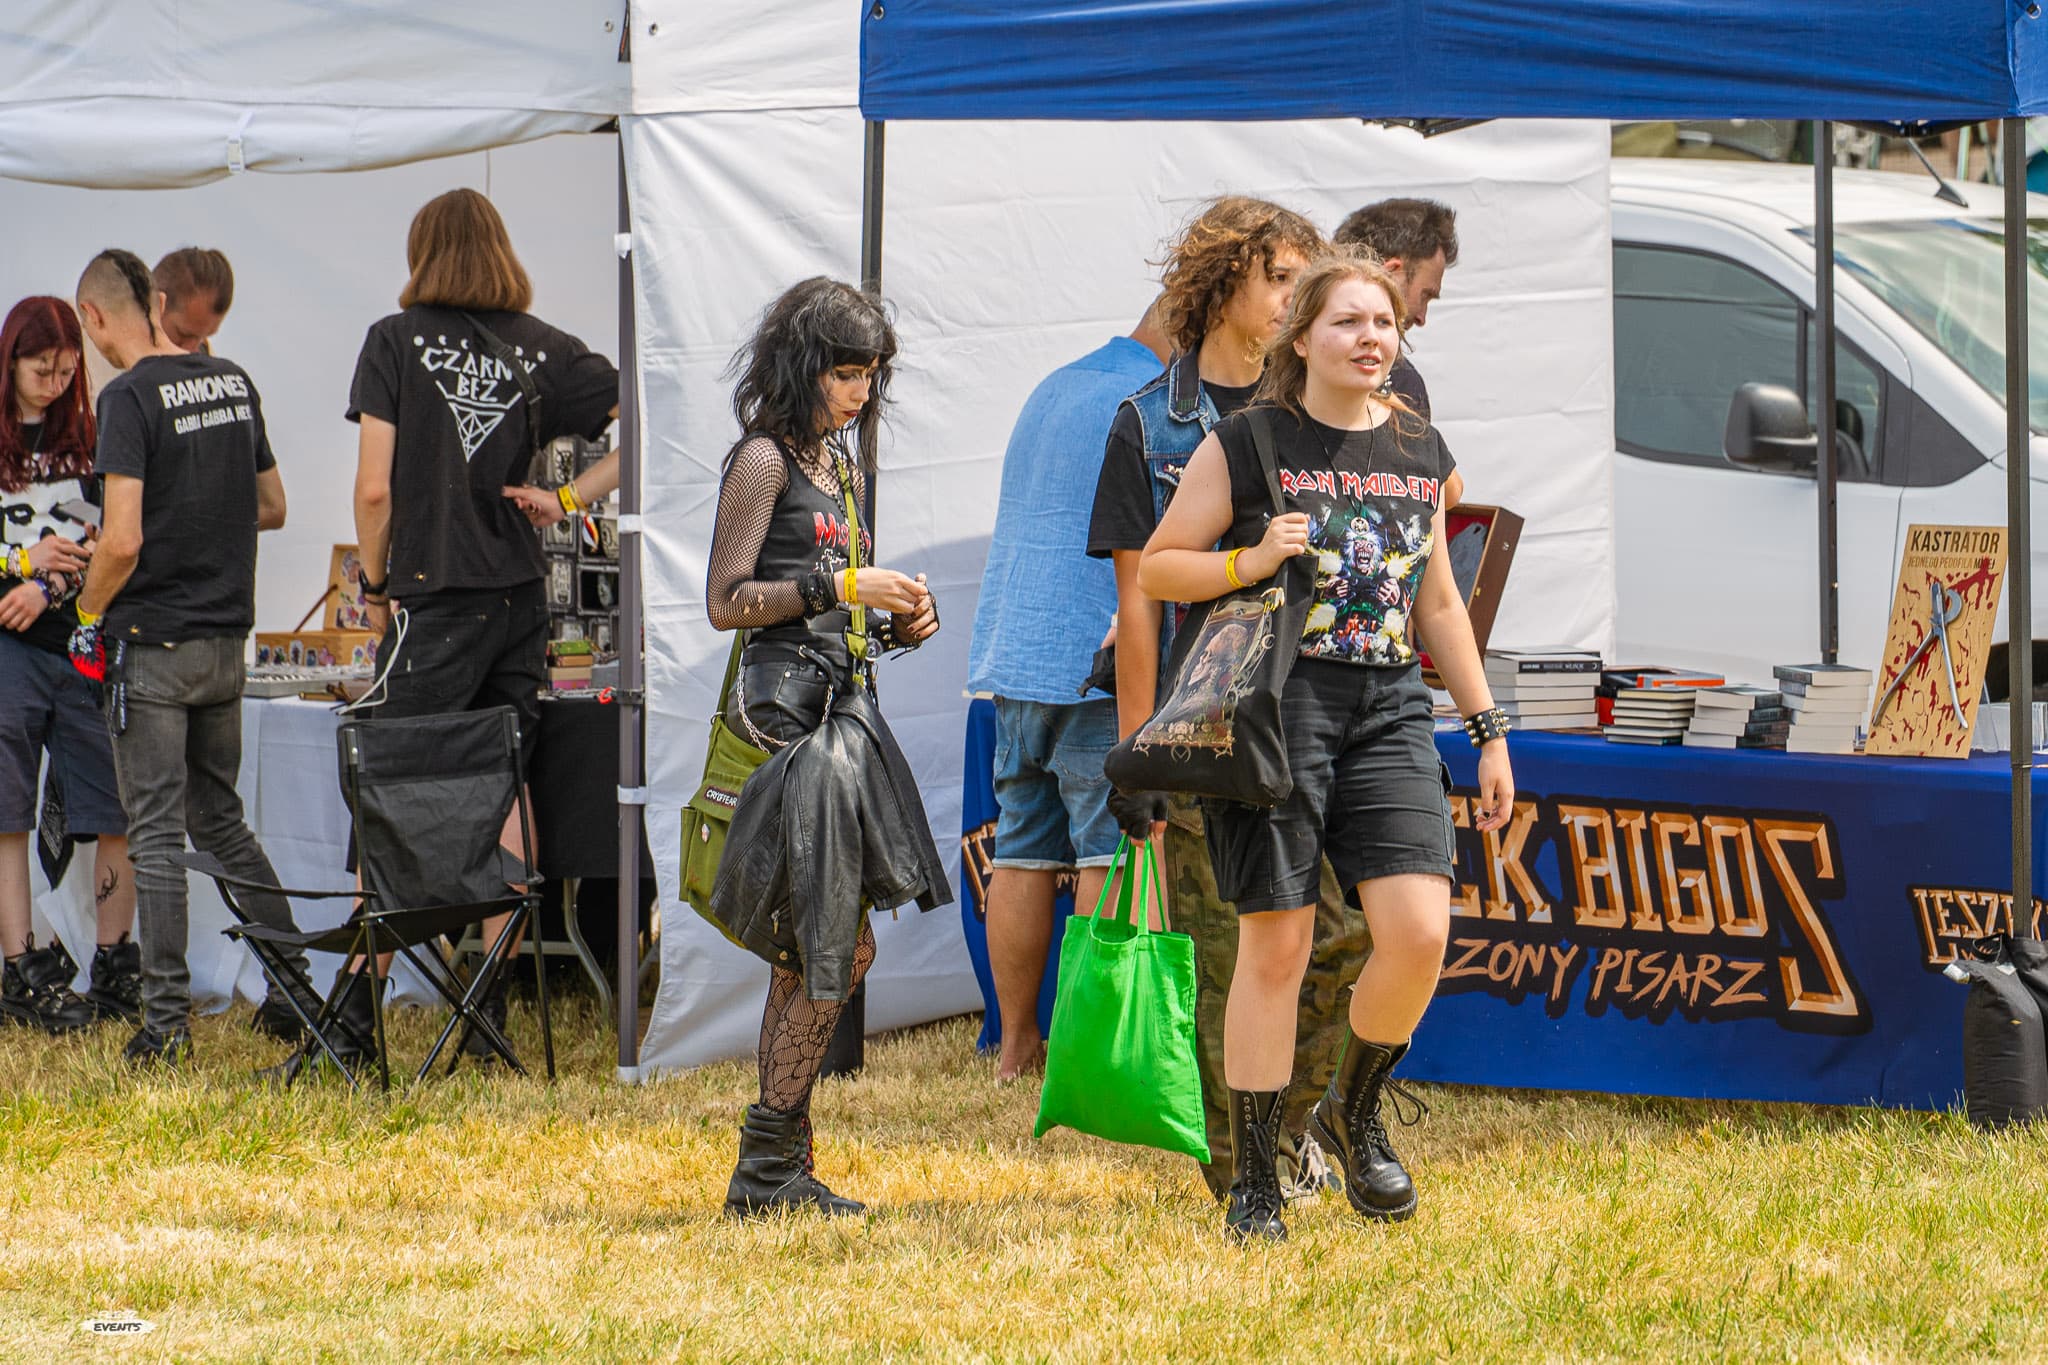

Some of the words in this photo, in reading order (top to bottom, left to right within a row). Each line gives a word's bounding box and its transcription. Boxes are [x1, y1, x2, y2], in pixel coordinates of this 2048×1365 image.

[159, 374, 249, 410] RAMONES
[456, 371, 498, 402] BEZ
[201, 406, 236, 428] GABBA
[1280, 468, 1338, 501] RON
[1338, 471, 1439, 511] MAIDEN
[1910, 530, 2000, 554] KASTRATOR
[1558, 803, 1859, 1017] BIGOS
[1440, 938, 1579, 1001] ZONY
[1591, 947, 1769, 1009] PISARZ
